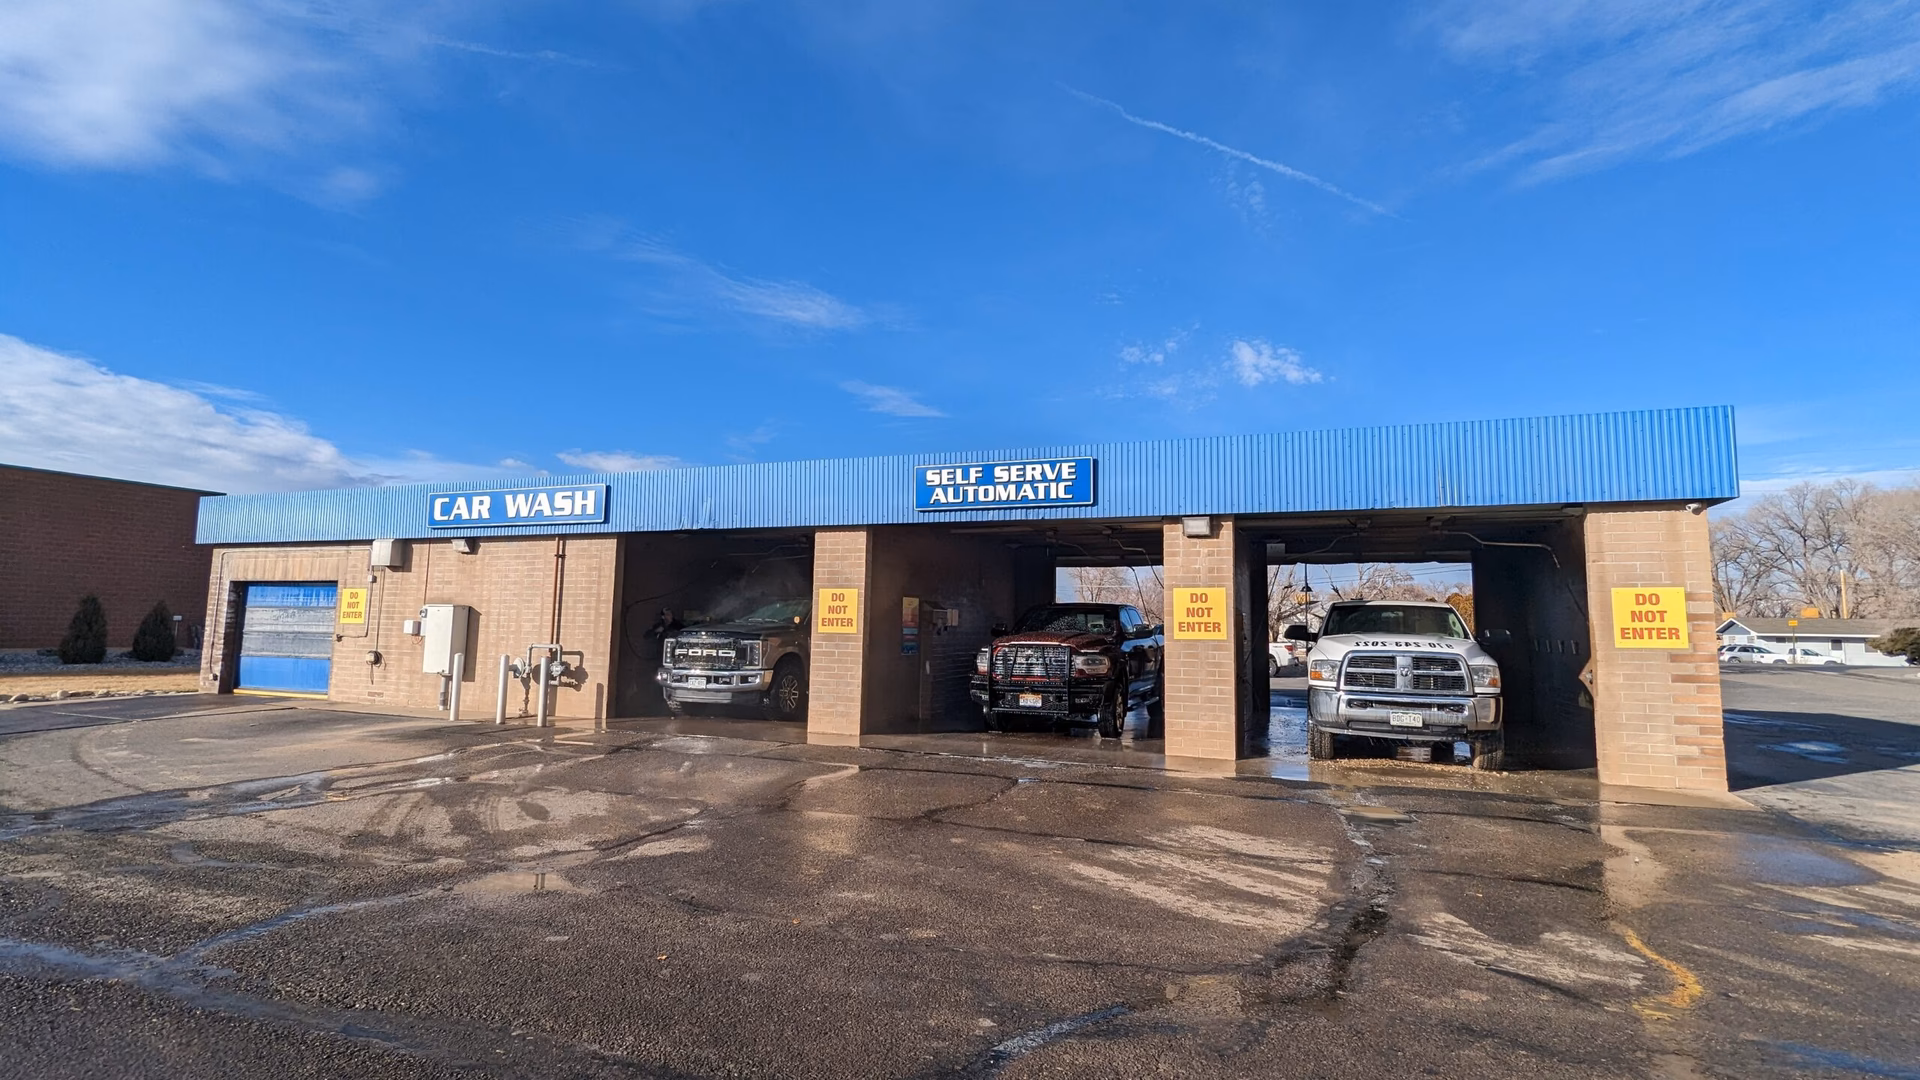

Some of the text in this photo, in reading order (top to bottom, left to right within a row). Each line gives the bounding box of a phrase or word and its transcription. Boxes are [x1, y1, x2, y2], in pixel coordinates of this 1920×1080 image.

[926, 462, 1077, 486] SELF SERVE
[929, 482, 1073, 504] AUTOMATIC
[433, 490, 596, 521] CAR WASH
[831, 593, 845, 602] DO
[1190, 592, 1209, 604] DO
[1635, 593, 1660, 606] DO
[828, 605, 848, 615] NOT
[1186, 607, 1213, 618] NOT
[821, 618, 854, 627] ENTER
[1630, 610, 1668, 623] NOT
[1178, 622, 1222, 633] ENTER
[1620, 627, 1681, 640] ENTER
[675, 648, 736, 657] FORD
